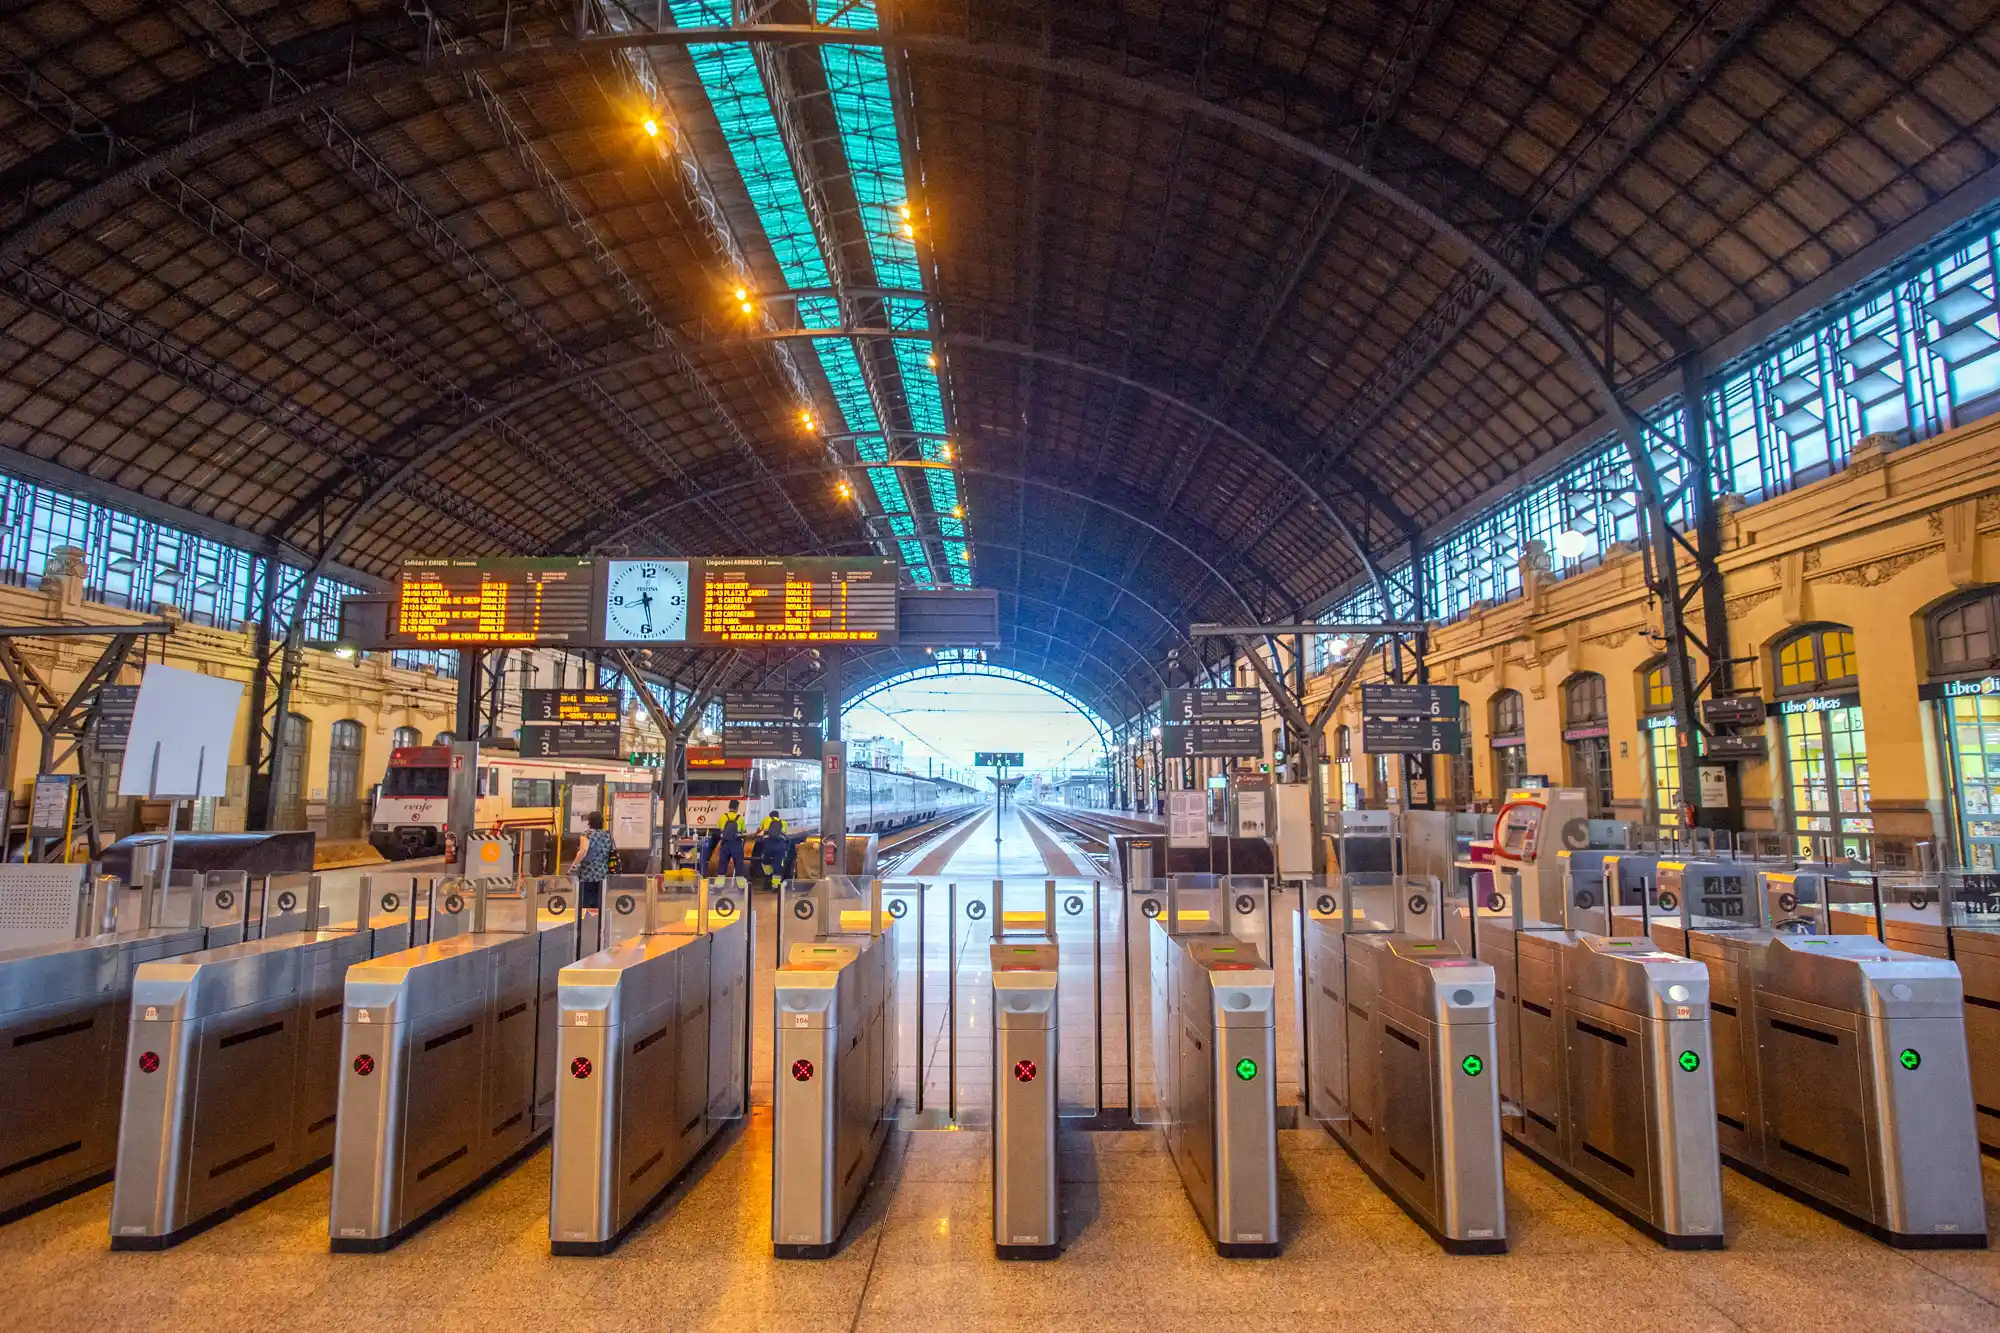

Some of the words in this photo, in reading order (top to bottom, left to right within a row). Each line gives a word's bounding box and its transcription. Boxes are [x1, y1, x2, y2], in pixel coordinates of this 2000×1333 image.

[642, 568, 656, 578] 12
[614, 596, 623, 606] 9
[671, 596, 680, 606] 3
[641, 624, 650, 634] 6
[1944, 680, 1981, 696] Libro
[543, 705, 552, 718] 3
[1184, 705, 1193, 718] 5
[1431, 701, 1440, 715] 6
[1781, 700, 1807, 713] Libro
[1816, 697, 1840, 711] ideas
[592, 712, 617, 720] SOLLANA
[793, 706, 803, 720] 4
[541, 742, 550, 755] 3
[792, 743, 802, 757] 4
[1185, 742, 1194, 755] 5
[1432, 738, 1441, 751] 6
[404, 802, 432, 813] renfe
[688, 803, 718, 814] renfe
